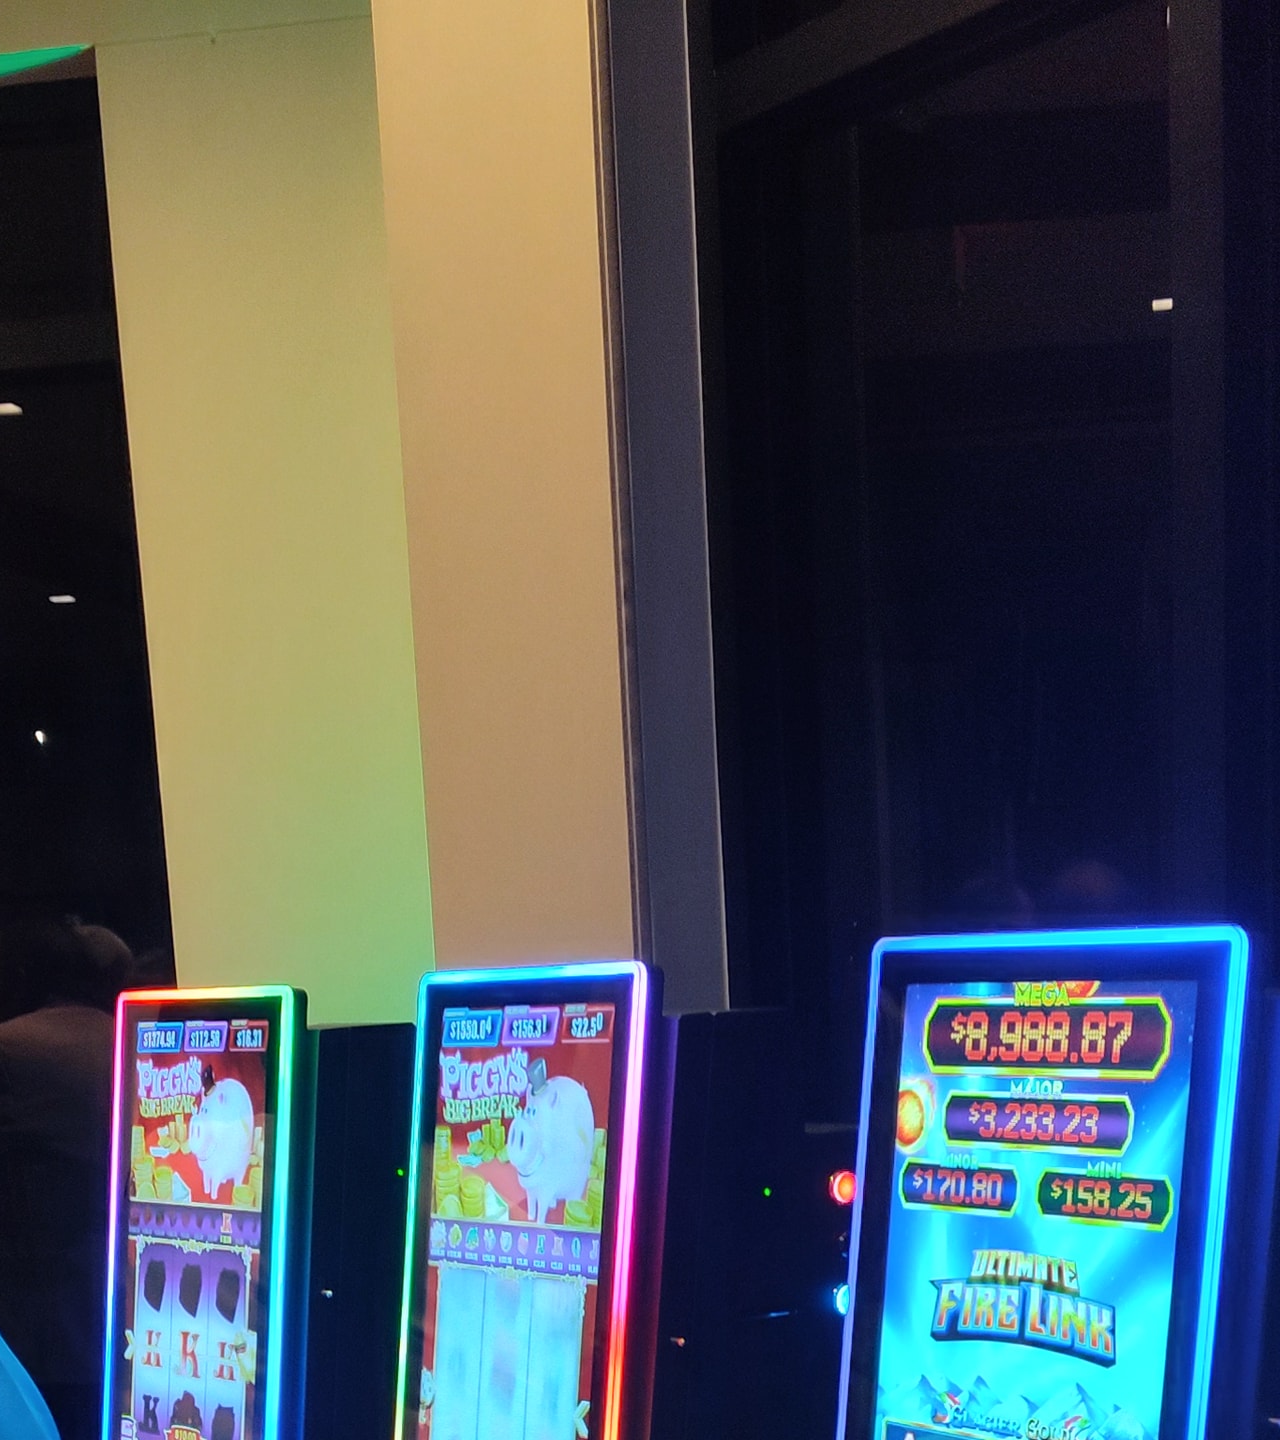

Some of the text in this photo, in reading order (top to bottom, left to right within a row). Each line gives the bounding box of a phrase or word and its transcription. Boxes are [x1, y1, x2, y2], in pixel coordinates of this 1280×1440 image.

[1014, 982, 1069, 1007] MEGA
[951, 1011, 1133, 1064] $8,988.87
[140, 1097, 161, 1118] BIG
[1010, 1079, 1064, 1099] MAJOR
[443, 1095, 522, 1124] BIG BREAK
[968, 1101, 1100, 1143] $3,233.23
[913, 1170, 1003, 1206] $170.80
[1087, 1162, 1123, 1178] MINI
[1050, 1176, 1154, 1219] $158.25
[971, 1248, 1080, 1290] ULTIMATE
[932, 1279, 1115, 1356] FIRE LINK
[175, 1330, 202, 1380] K
